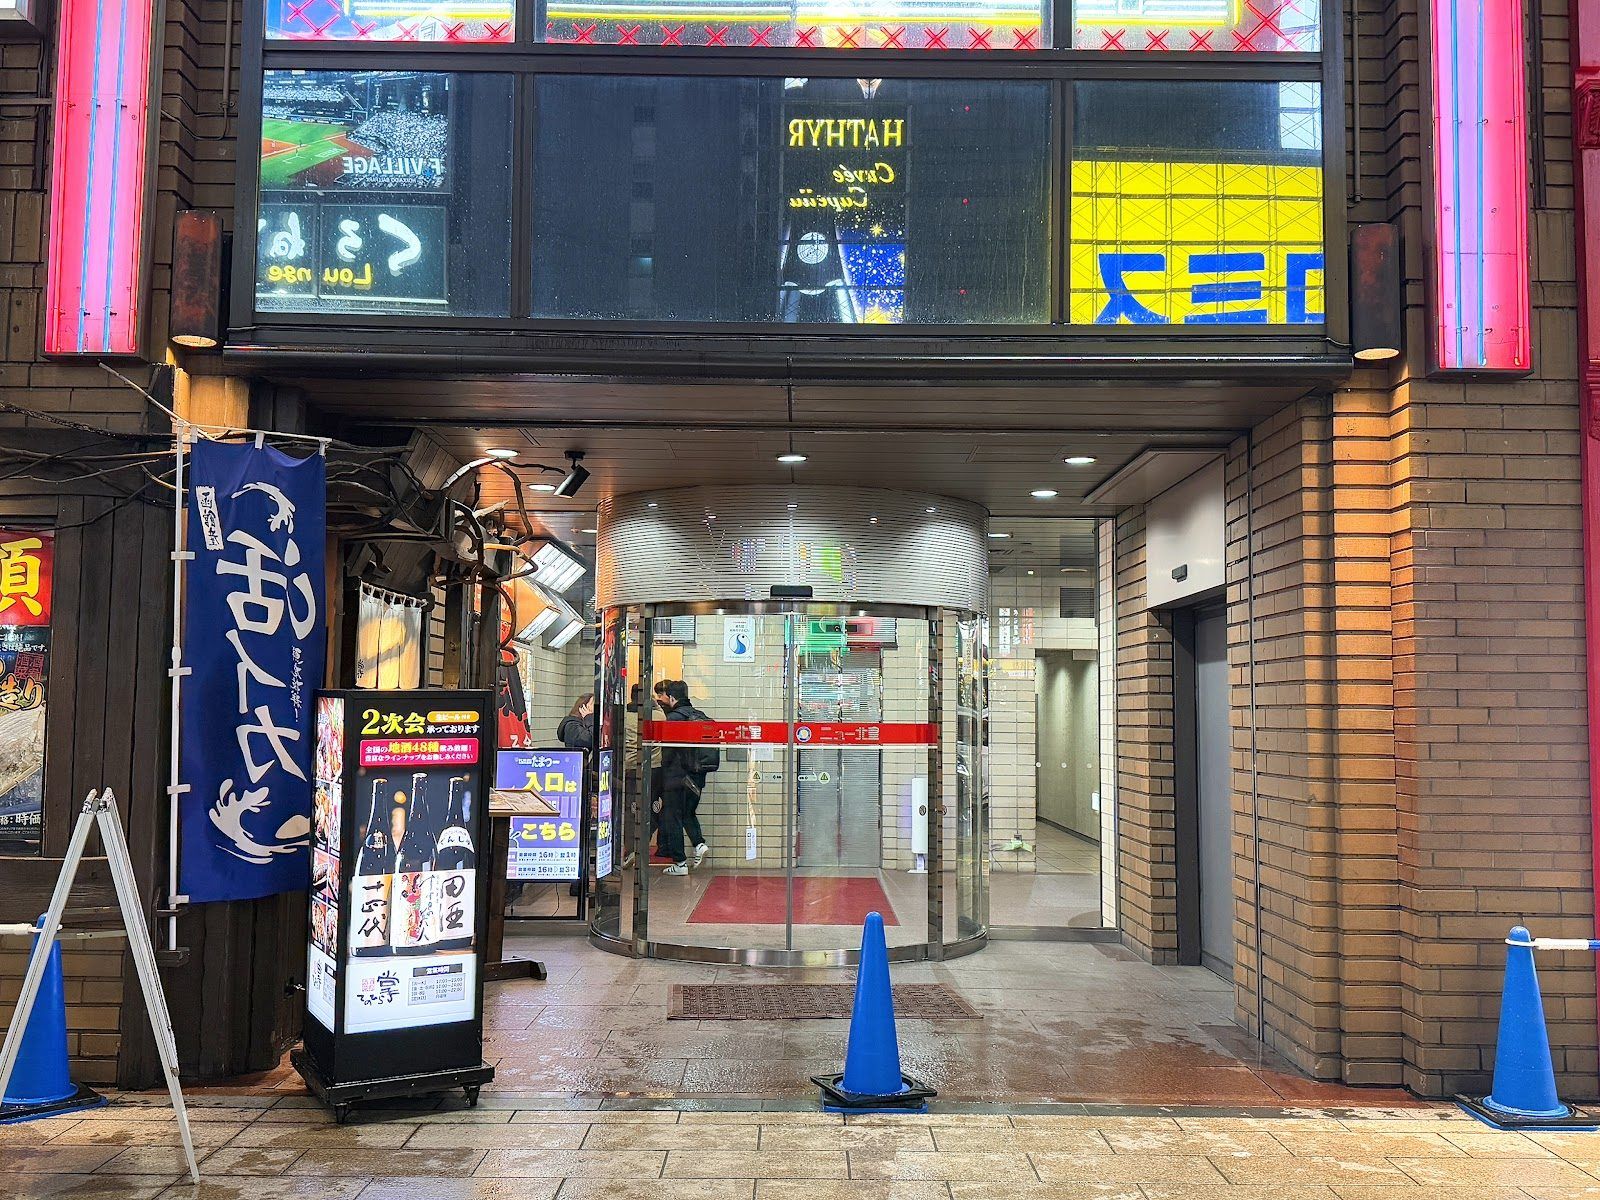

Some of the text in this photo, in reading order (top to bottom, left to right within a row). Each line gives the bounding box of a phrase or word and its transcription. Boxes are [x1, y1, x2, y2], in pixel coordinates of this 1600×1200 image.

[361, 708, 427, 735] 2次会
[520, 821, 577, 842] こちら
